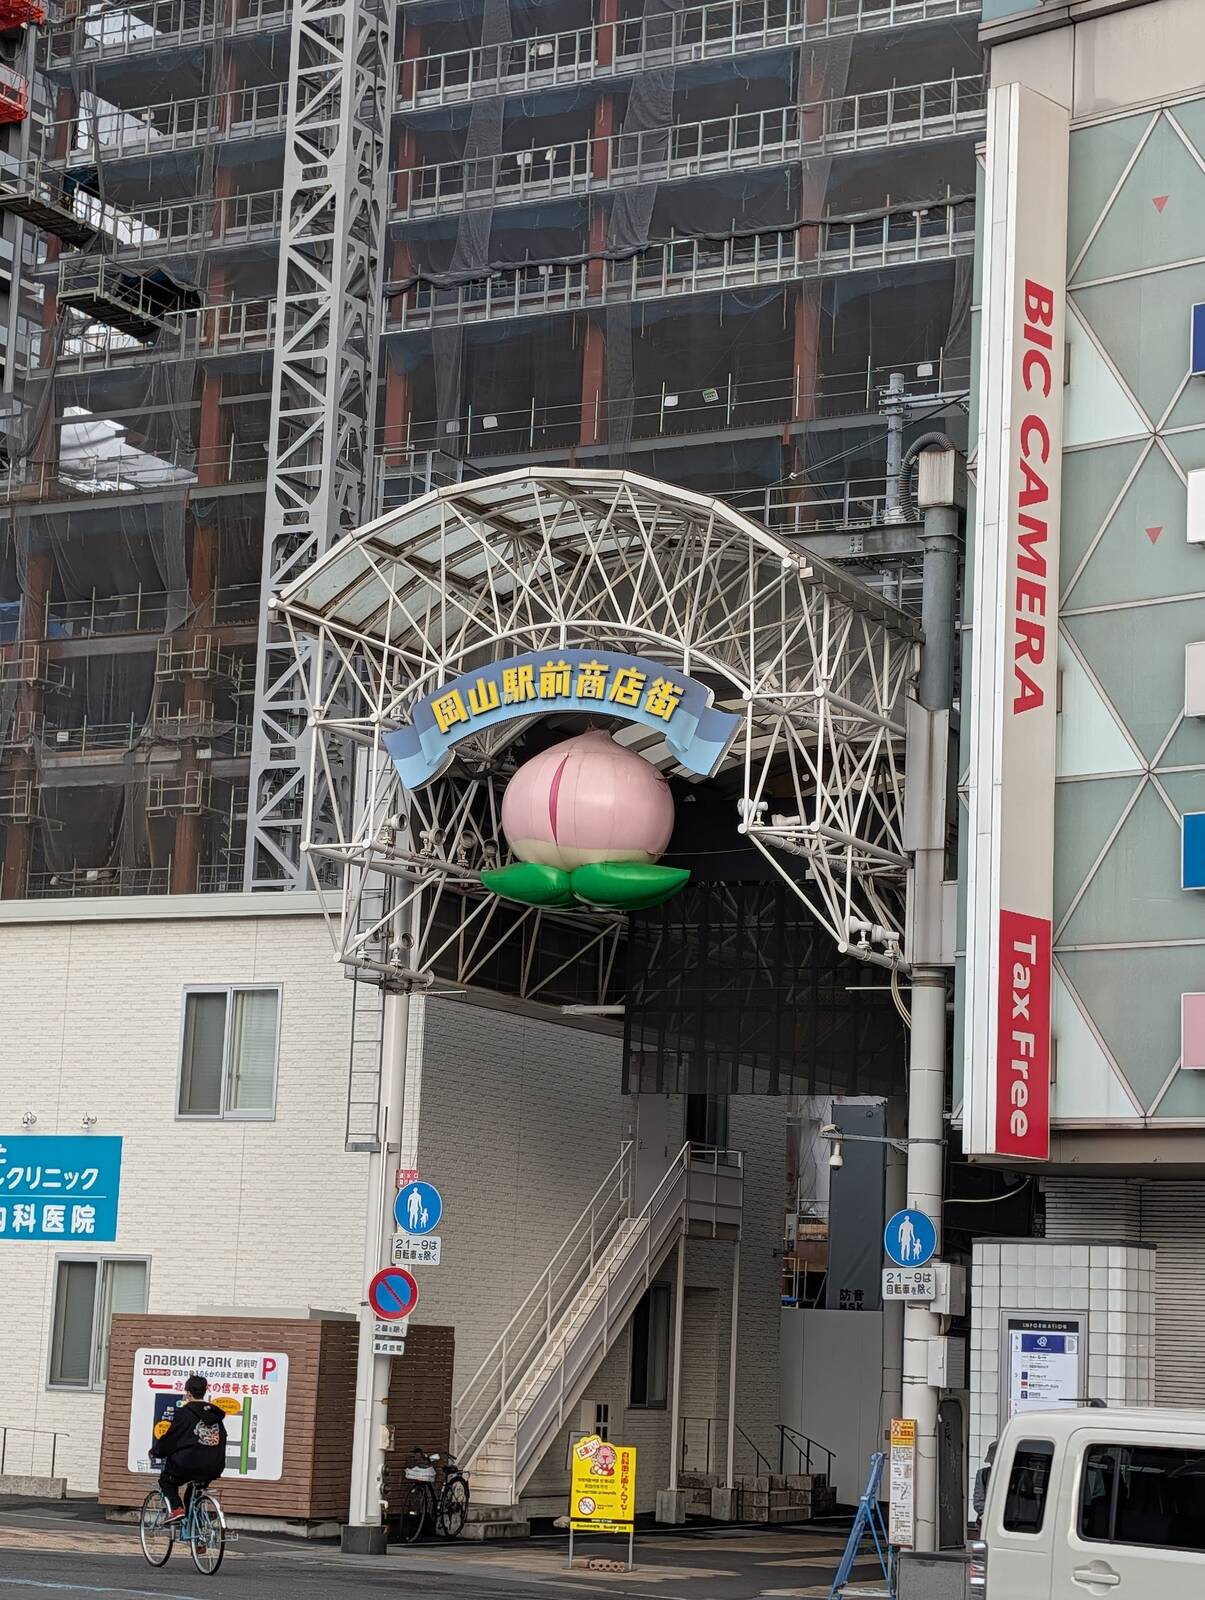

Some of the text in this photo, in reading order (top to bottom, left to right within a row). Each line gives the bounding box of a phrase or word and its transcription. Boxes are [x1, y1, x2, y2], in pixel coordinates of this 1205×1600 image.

[1013, 278, 1054, 716] BIC CAMERA
[431, 659, 685, 734] 岡山駅前商店街
[1010, 934, 1037, 1138] Tax Free
[0, 1166, 99, 1190] クリニック
[394, 1250, 437, 1262] 自転車を除く
[840, 1288, 865, 1302] 防音
[886, 1284, 932, 1296] 自転車を除く
[262, 1357, 277, 1380] P
